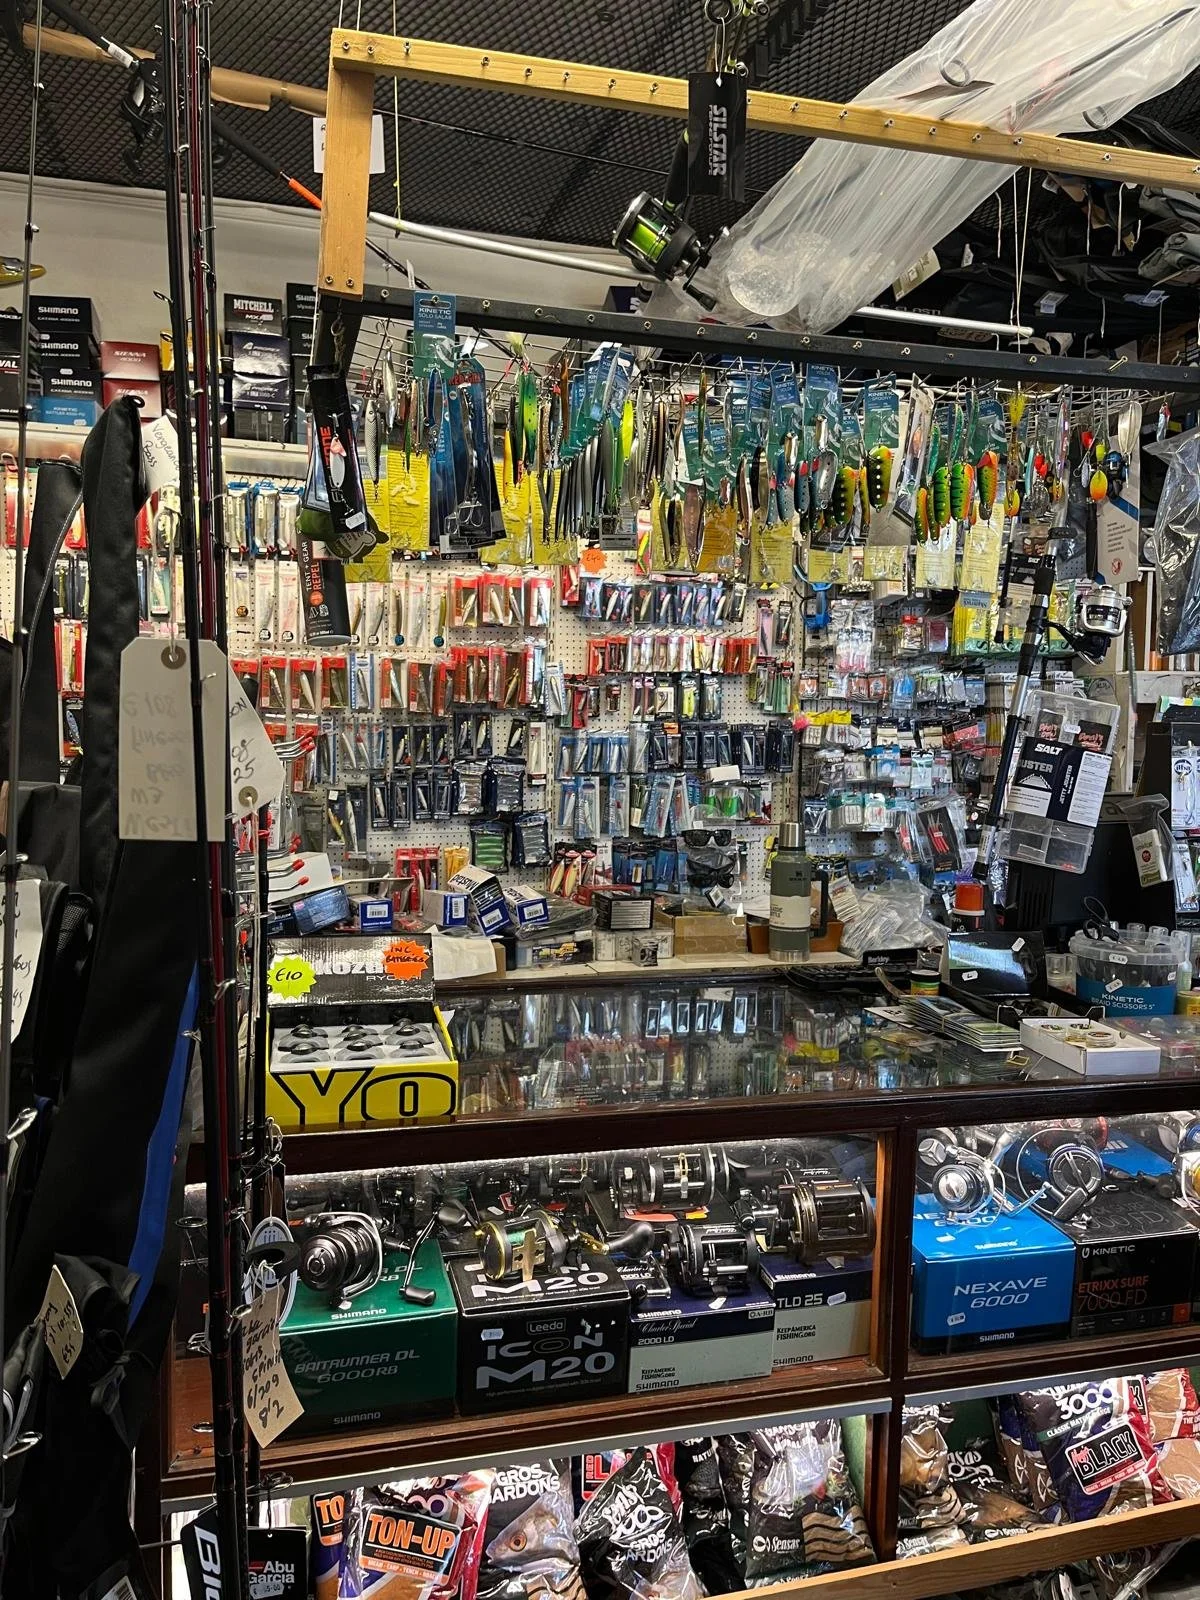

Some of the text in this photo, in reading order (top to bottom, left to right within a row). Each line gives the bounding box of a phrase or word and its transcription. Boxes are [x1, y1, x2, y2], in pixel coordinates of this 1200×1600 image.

[712, 104, 728, 176] SILSTAR
[38, 306, 79, 315] SHIMANO
[233, 298, 275, 313] MITCHELL
[418, 307, 451, 315] KINETIC
[50, 378, 93, 387] SHIMANO
[302, 541, 311, 564] GEAR
[1034, 743, 1063, 756] SALT
[1019, 759, 1054, 774] USTER
[1101, 993, 1144, 1004] KINETIC
[1111, 1001, 1149, 1010] SCISSORS
[1092, 1244, 1136, 1256] KINETIC
[775, 1272, 817, 1280] SHIMANO
[470, 1272, 609, 1298] M20
[953, 1276, 1048, 1297] NEXAVE
[1077, 1275, 1150, 1294] ETRIXX SURF
[776, 1292, 823, 1309] TLD 25
[970, 1293, 1030, 1309] 6000
[330, 1307, 387, 1320] SHIMANO
[637, 1309, 682, 1319] SHIMANO
[529, 1321, 564, 1333] Leeda
[637, 1337, 662, 1346] 2000
[979, 1332, 1015, 1343] SHIMANO
[294, 1352, 391, 1374] BAITRUNNER
[394, 1349, 421, 1362] DL
[772, 1354, 814, 1366] SHIMANO
[316, 1364, 399, 1384] 6000RB
[475, 1351, 615, 1390] M20
[635, 1379, 680, 1391] SHIMANO
[1055, 1385, 1114, 1420] 3000
[333, 1410, 382, 1426] SHIMANO
[1046, 1422, 1071, 1438] CLASSIC
[1077, 1430, 1137, 1477] BLACK
[495, 1463, 545, 1488] GROS
[487, 1475, 561, 1505] ARDONS
[367, 1513, 456, 1558] TON-UP
[626, 1538, 673, 1563] ARDONS
[771, 1535, 801, 1553] Sensas
[262, 1560, 295, 1574] Abu
[248, 1571, 295, 1584] Garcia
